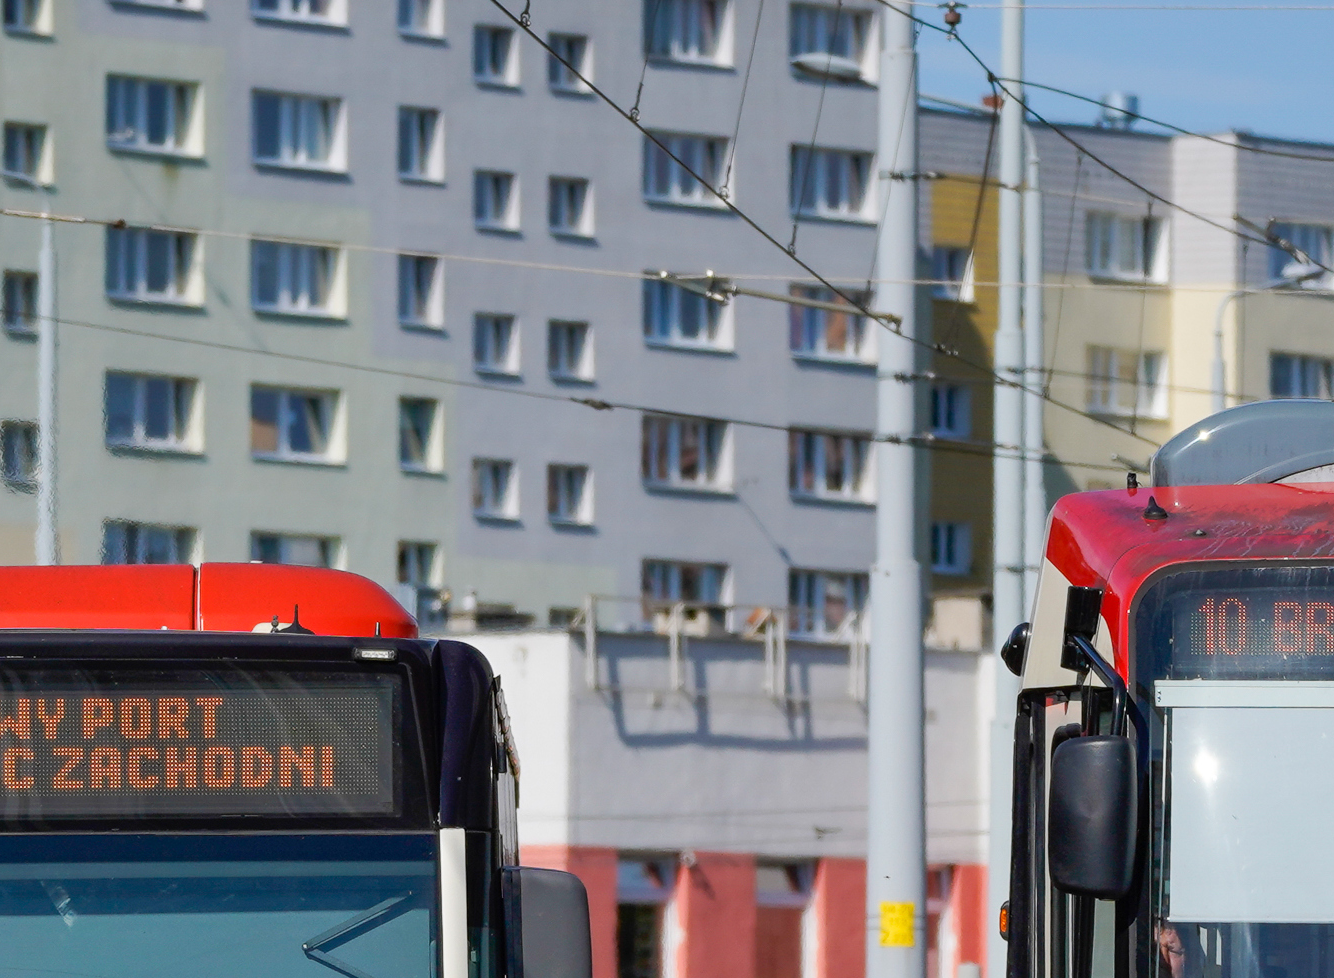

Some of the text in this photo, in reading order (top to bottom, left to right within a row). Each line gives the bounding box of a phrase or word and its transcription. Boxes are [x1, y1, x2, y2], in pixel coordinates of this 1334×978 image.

[1198, 598, 1246, 655] 10
[82, 697, 224, 740] PORT
[53, 745, 334, 789] ZACHODNI
